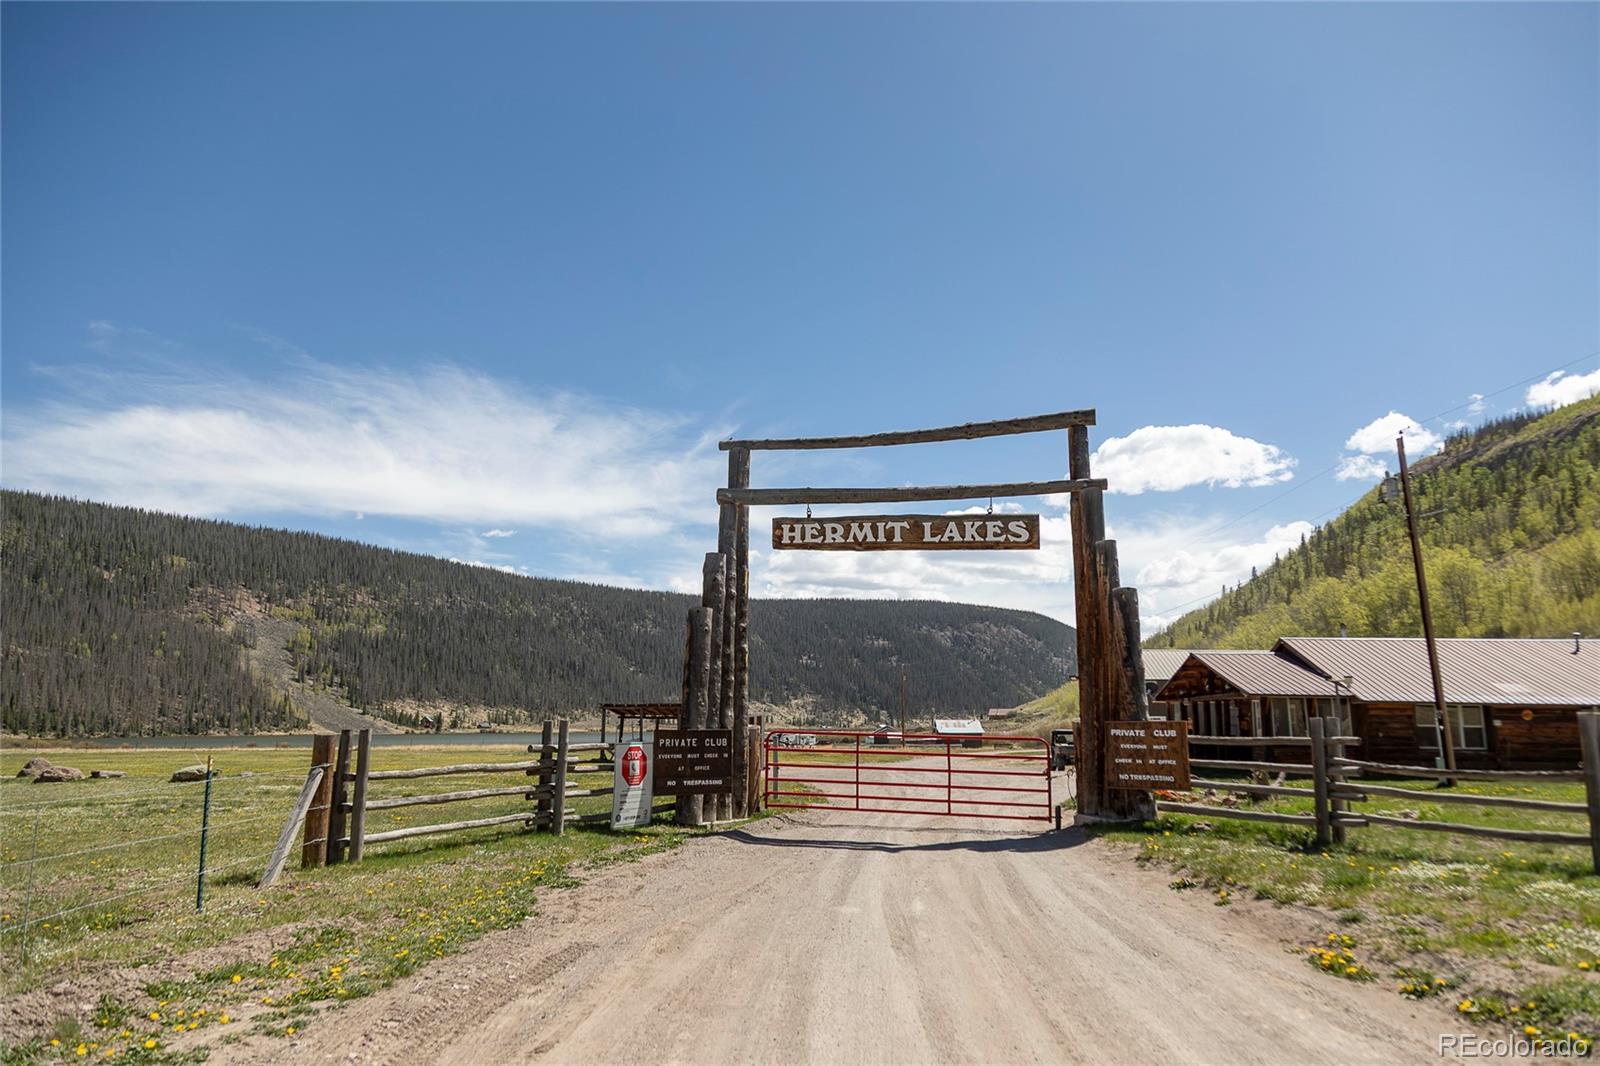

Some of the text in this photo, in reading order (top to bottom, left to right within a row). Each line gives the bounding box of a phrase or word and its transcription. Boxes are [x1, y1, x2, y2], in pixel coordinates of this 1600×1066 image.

[781, 520, 1030, 544] HERMIT LAKES
[1110, 729, 1177, 737] PRIVATE CLUB
[659, 738, 728, 747] PRIVATE CLUB
[627, 751, 643, 760] STOP
[1130, 774, 1175, 782] TRESPASSING
